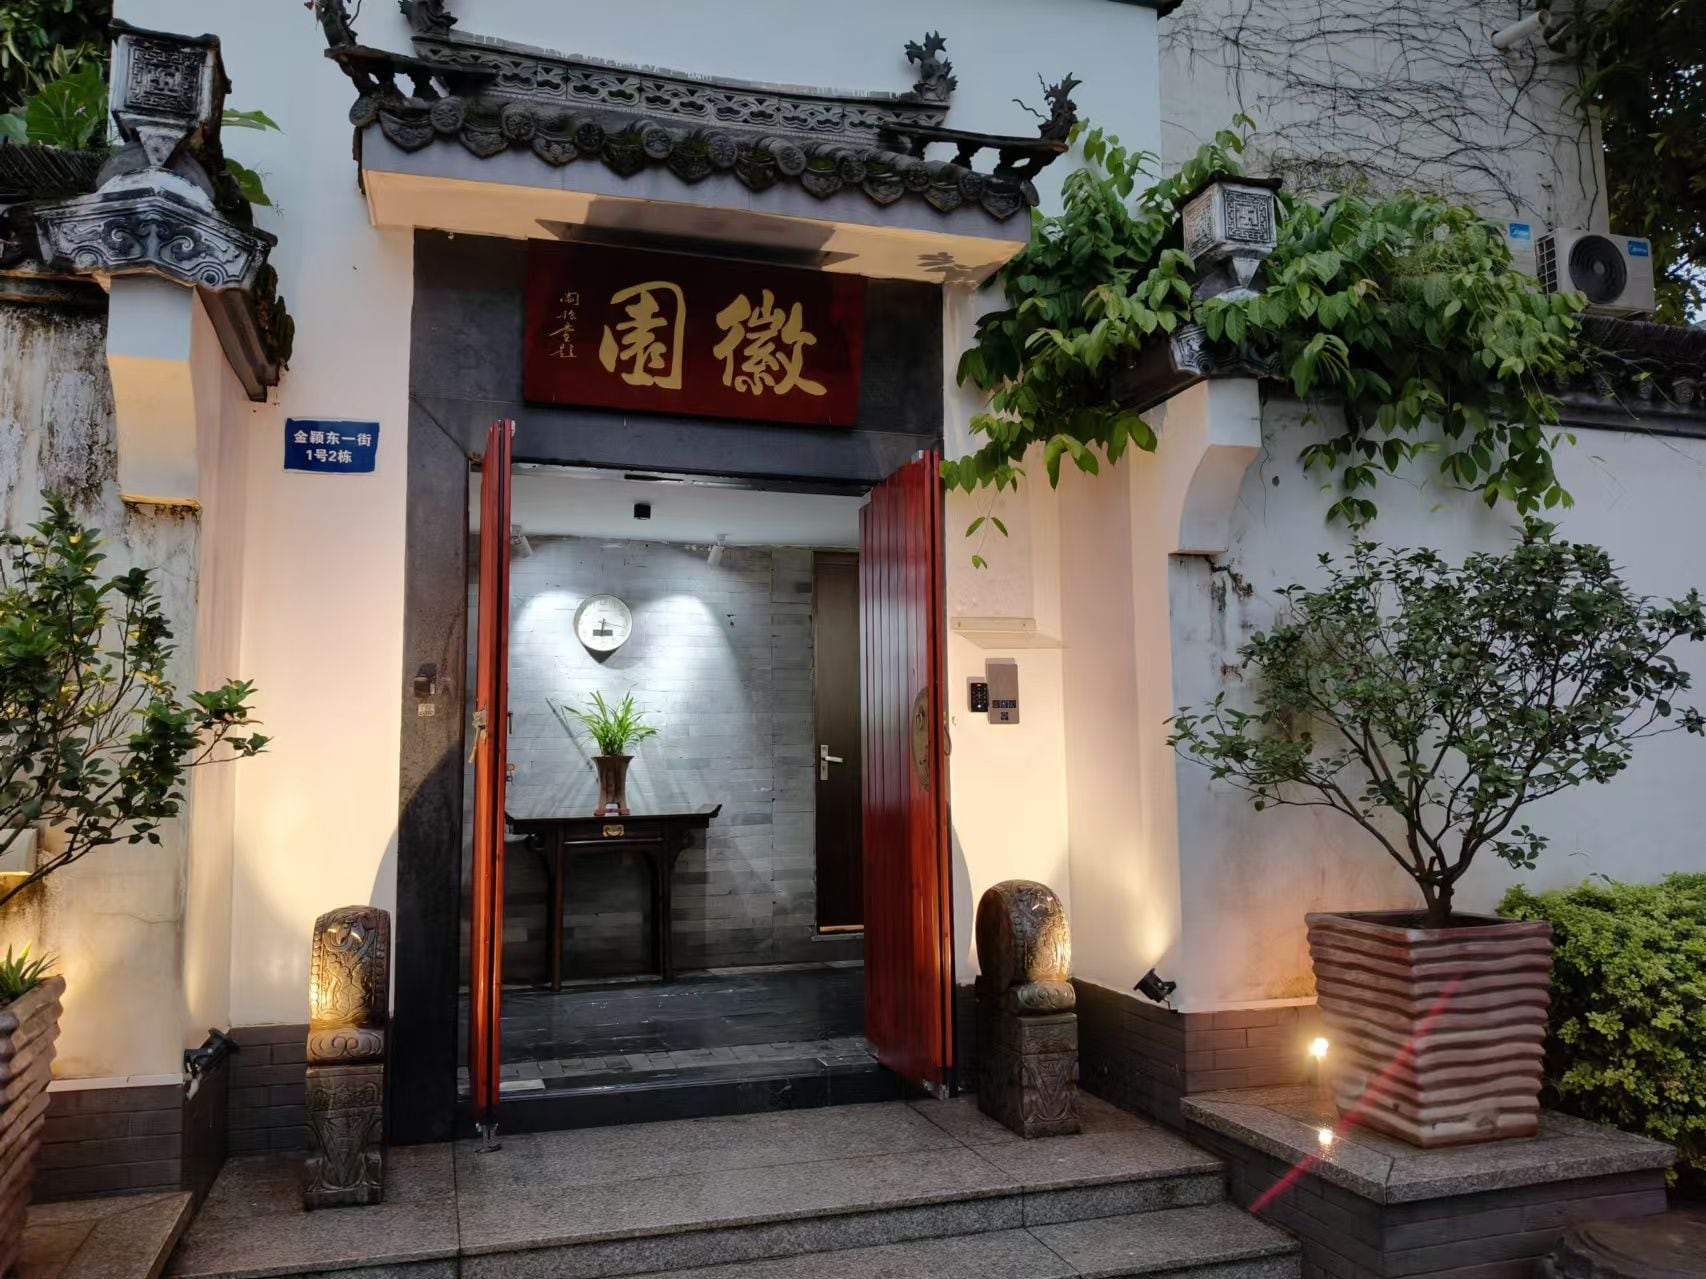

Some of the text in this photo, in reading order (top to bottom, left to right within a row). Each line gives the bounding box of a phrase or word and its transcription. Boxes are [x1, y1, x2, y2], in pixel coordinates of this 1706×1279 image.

[293, 429, 372, 447] 金颖东一街
[305, 448, 353, 464] 1号2栋
